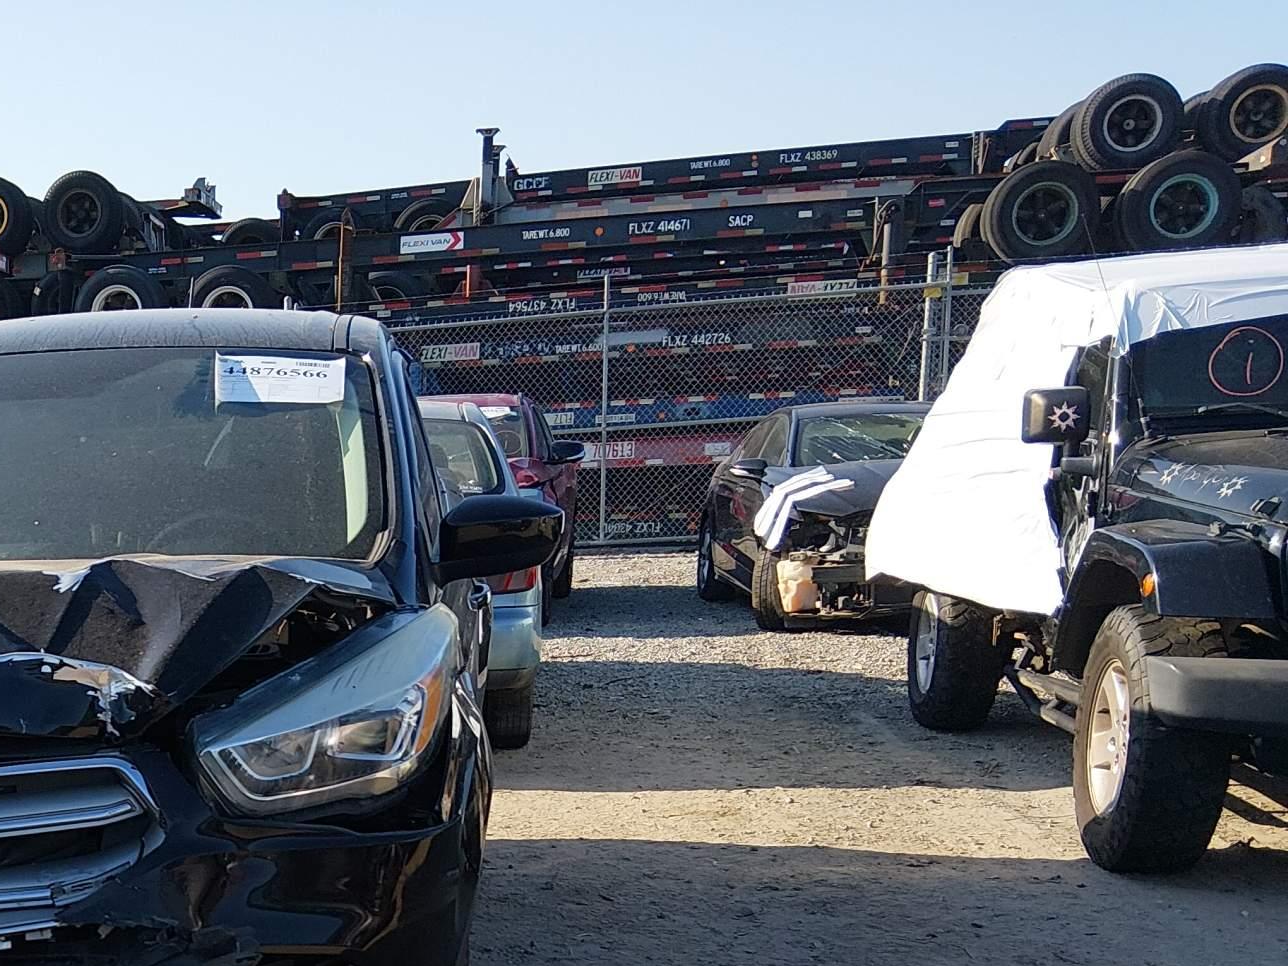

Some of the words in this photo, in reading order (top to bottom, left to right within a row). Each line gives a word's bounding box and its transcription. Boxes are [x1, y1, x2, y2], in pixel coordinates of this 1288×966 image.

[780, 152, 801, 163] FLXZ
[805, 150, 838, 161] 438369
[589, 168, 640, 183] FLEXI-VAN
[629, 222, 654, 234] FLXZ
[657, 219, 690, 231] 414671
[728, 215, 754, 227] SACP
[402, 241, 429, 249] FLEXI
[431, 238, 451, 246] VAN
[551, 297, 576, 310] FLXZ
[662, 335, 687, 347] FLXZ
[223, 366, 328, 379] 44876566
